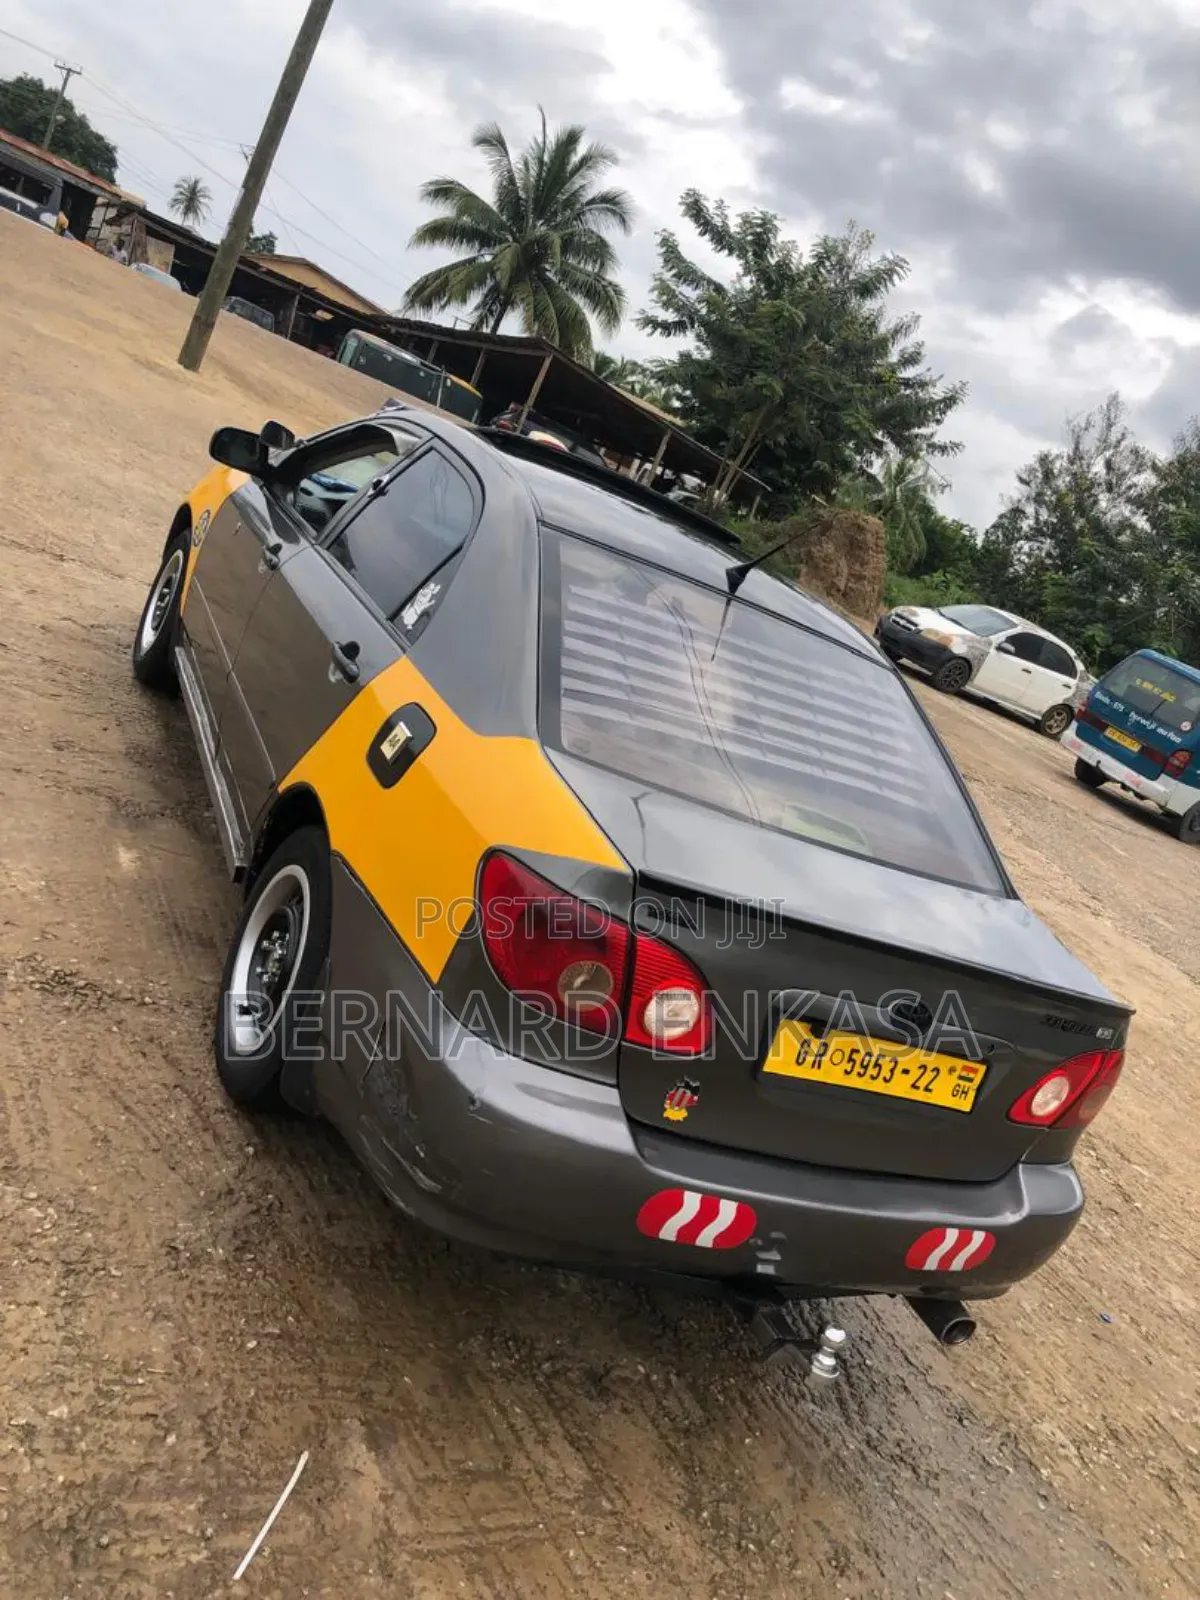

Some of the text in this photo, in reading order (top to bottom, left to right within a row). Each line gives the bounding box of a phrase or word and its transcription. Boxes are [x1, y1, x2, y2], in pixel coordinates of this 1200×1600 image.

[794, 1037, 941, 1094] GR 5953-22
[951, 1083, 971, 1101] GH
